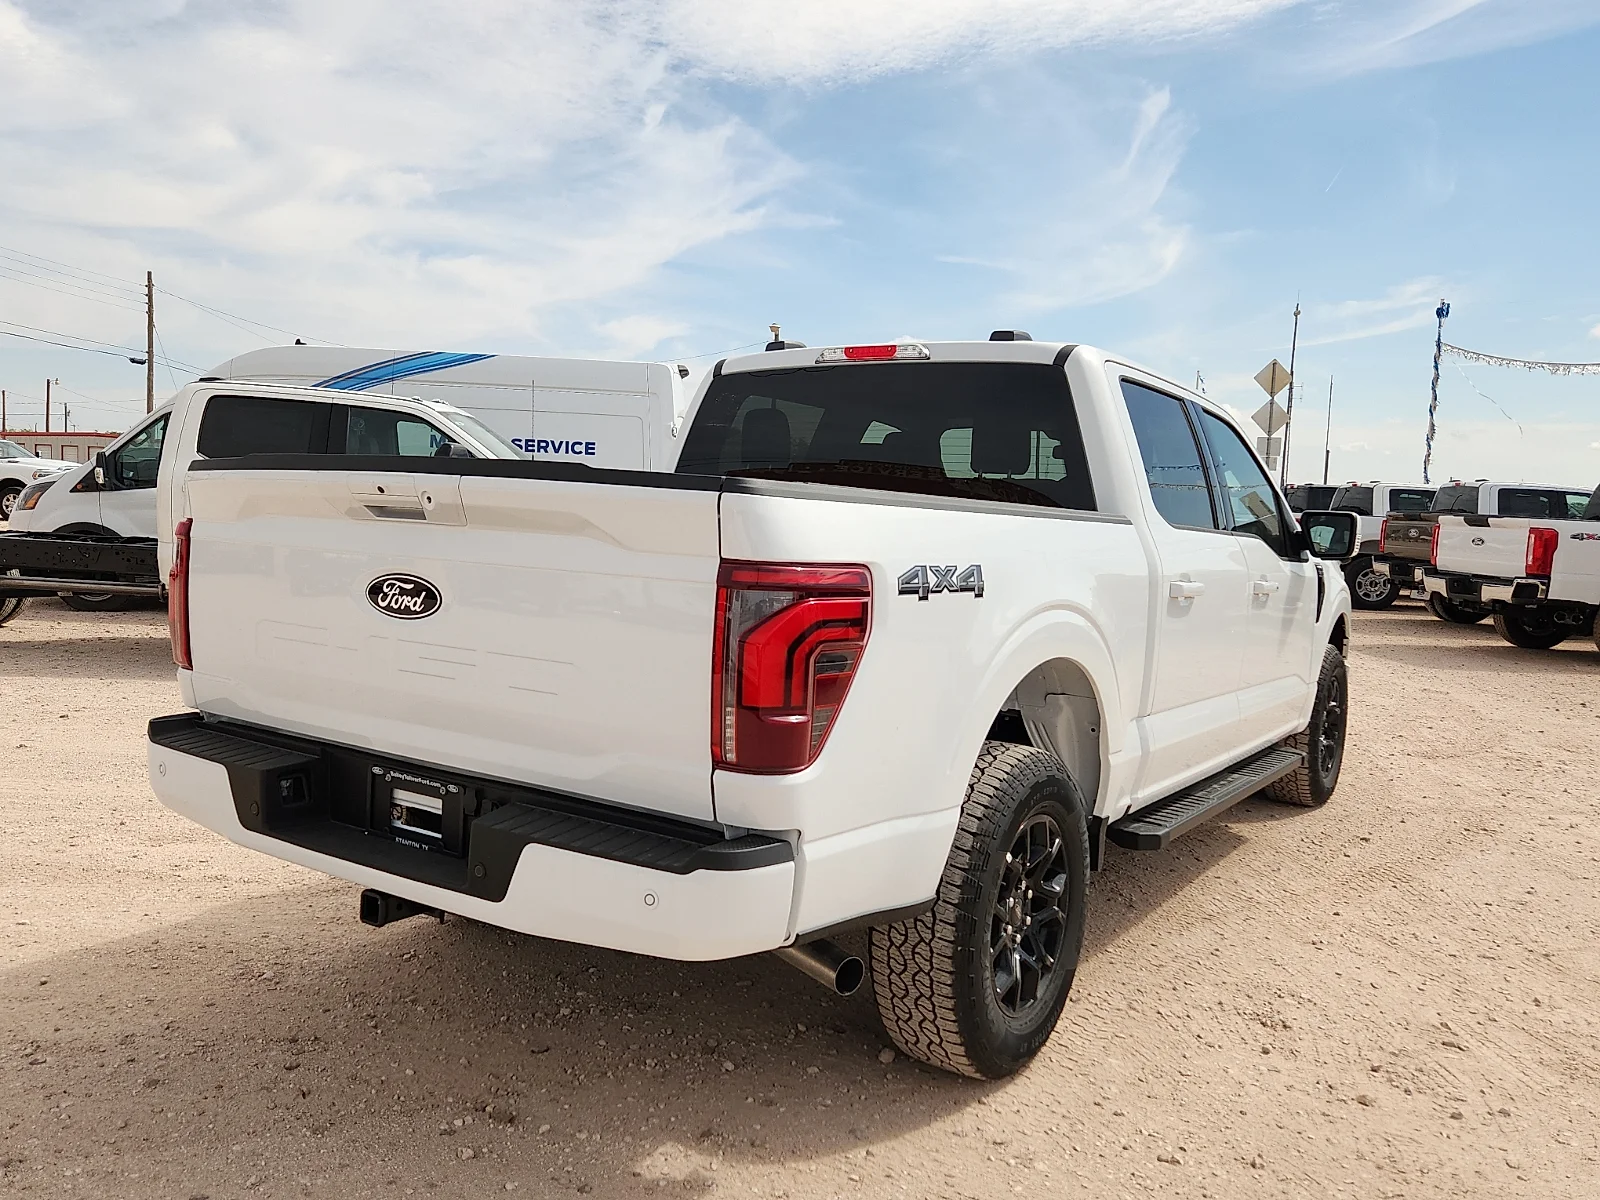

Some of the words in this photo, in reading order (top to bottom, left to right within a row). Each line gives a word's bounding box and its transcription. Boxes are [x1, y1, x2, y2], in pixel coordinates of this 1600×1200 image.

[511, 438, 596, 456] SERVICE
[1570, 532, 1600, 541] 4X
[377, 579, 427, 612] Ford
